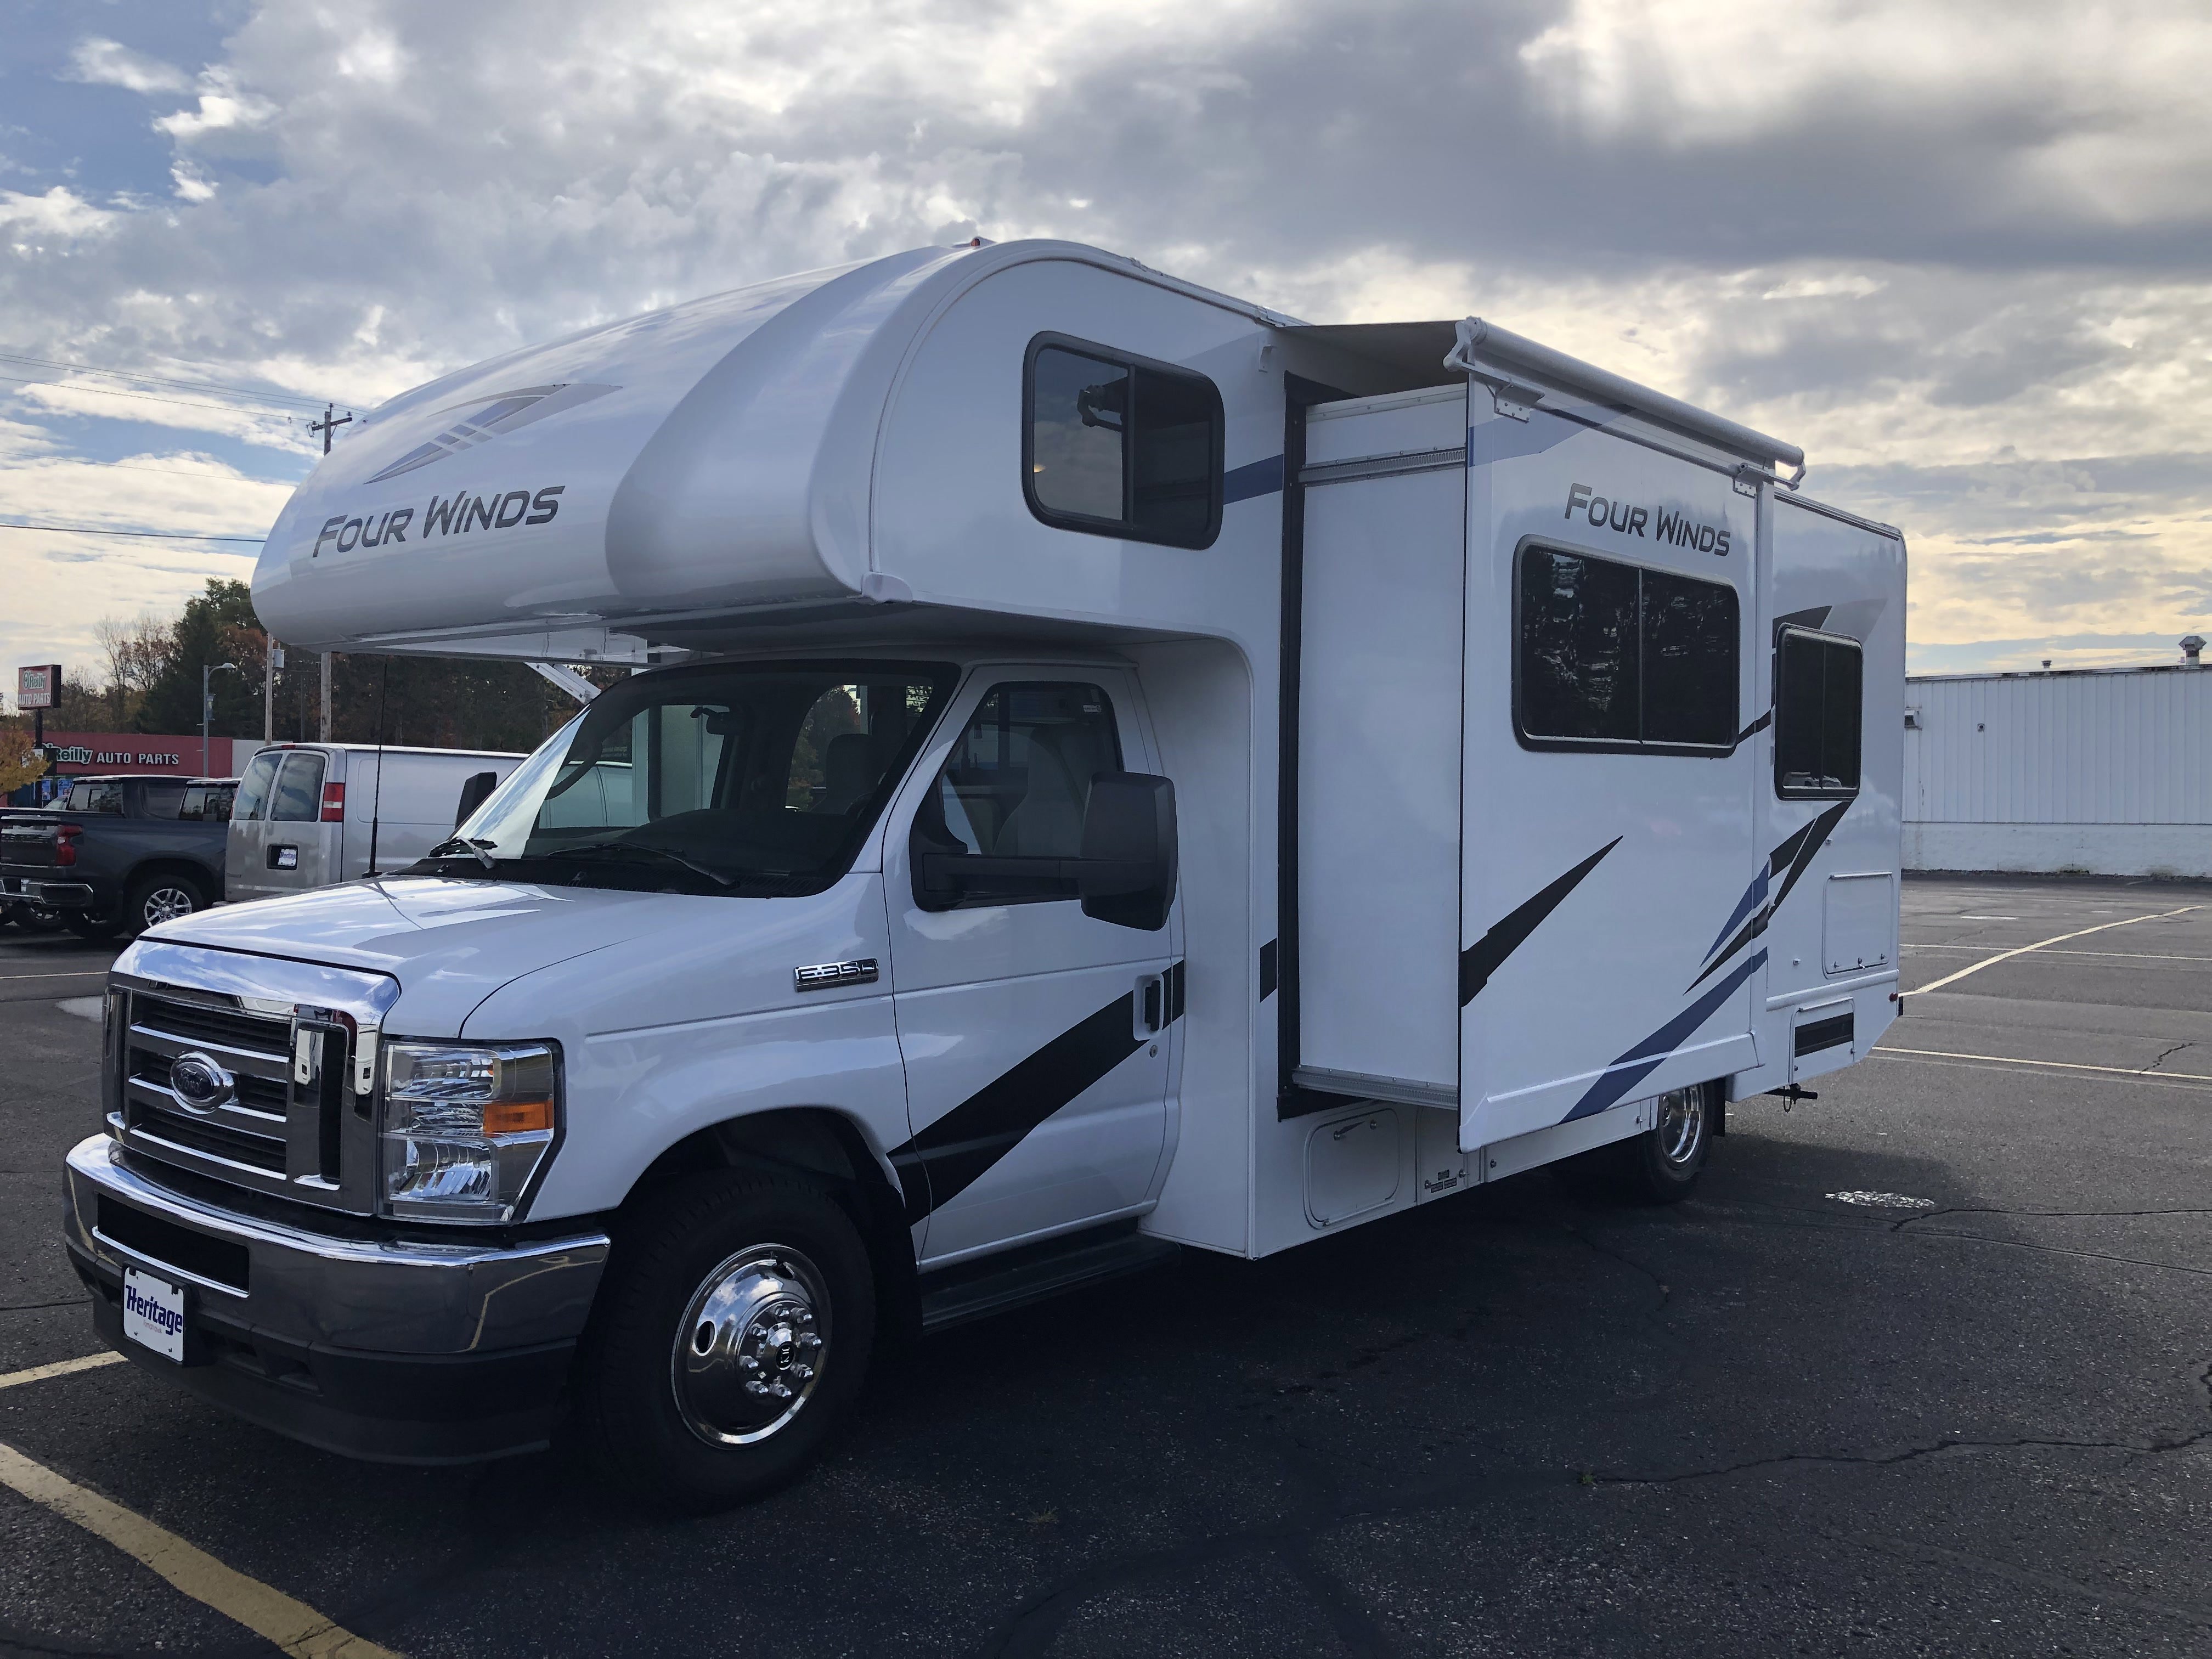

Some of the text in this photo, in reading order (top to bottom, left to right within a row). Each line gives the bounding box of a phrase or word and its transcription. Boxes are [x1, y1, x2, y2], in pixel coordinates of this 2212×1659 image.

[313, 486, 566, 558] FOUR WINDS
[1564, 483, 1731, 557] FOUR WINDS
[19, 692, 50, 706] AUTO PARTS
[24, 670, 46, 691] O'Reilly
[43, 743, 179, 765] 'Reilly AUTO PARTS
[126, 1284, 183, 1336] Heritage
